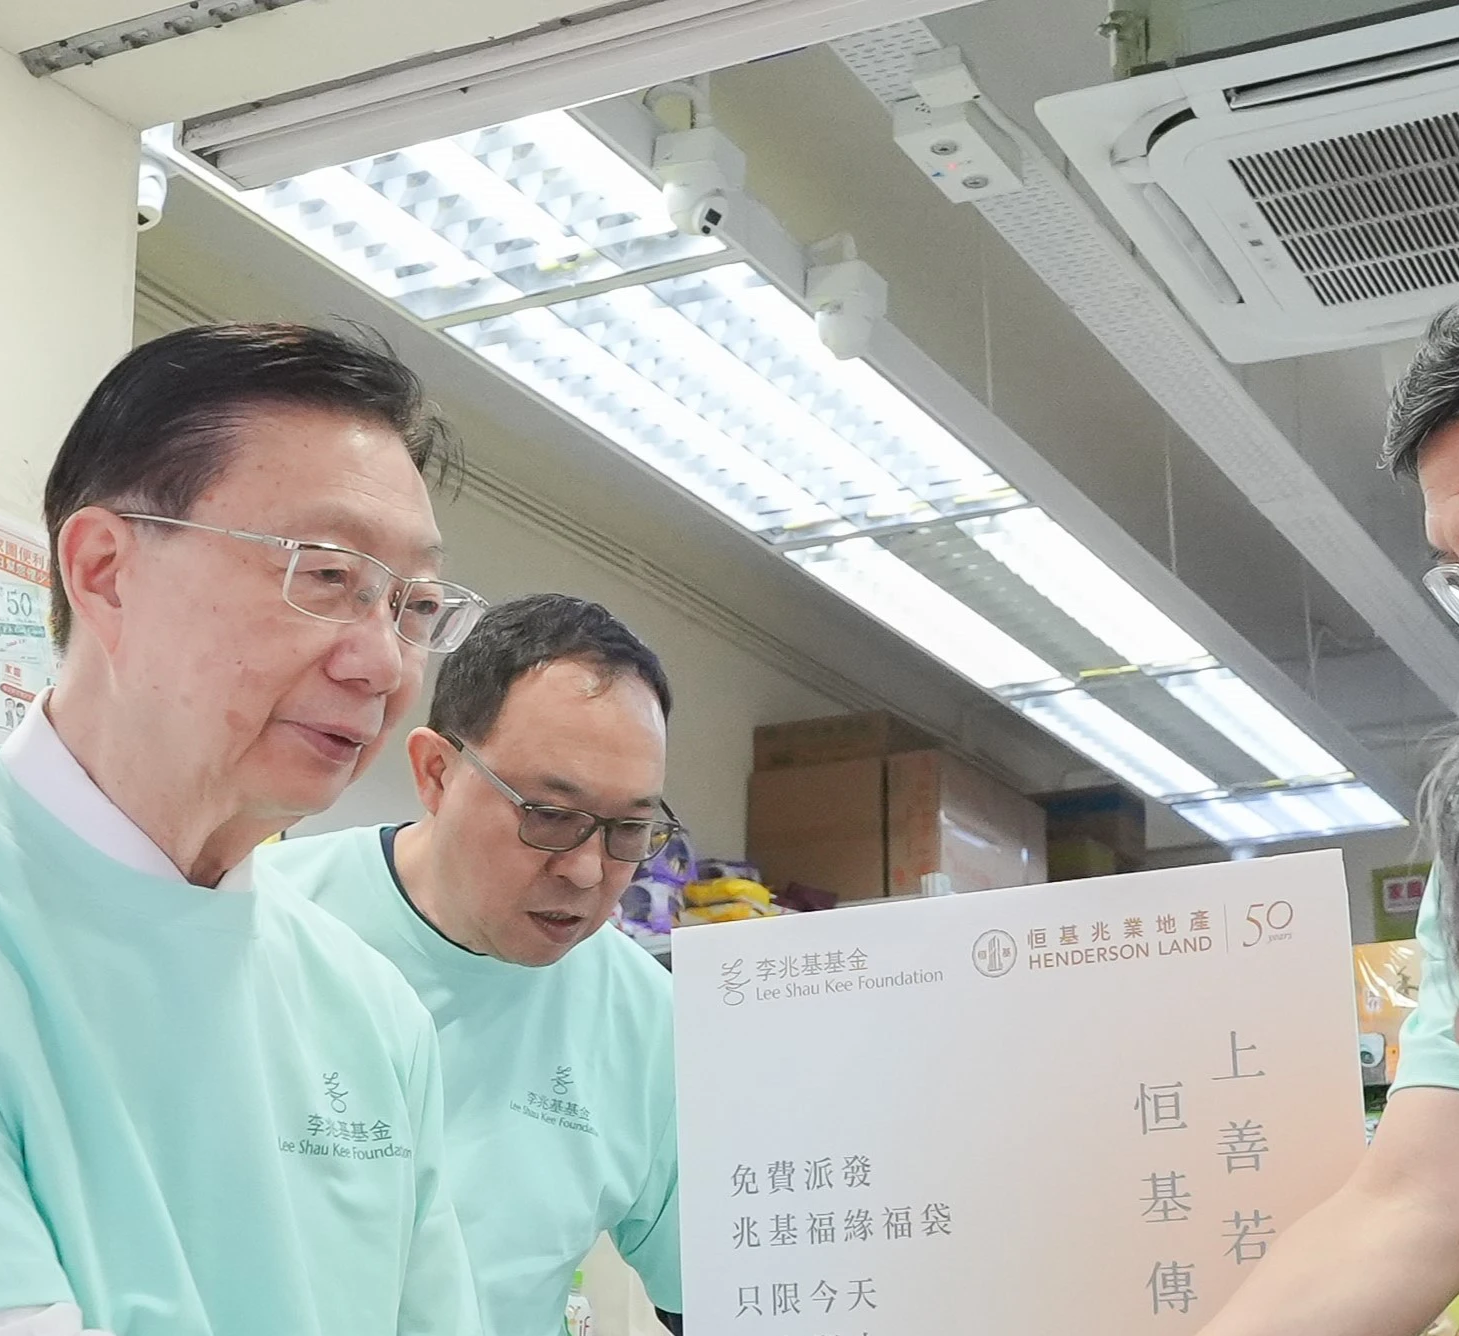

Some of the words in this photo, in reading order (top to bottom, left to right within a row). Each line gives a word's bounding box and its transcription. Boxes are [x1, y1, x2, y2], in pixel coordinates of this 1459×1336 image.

[1027, 910, 1211, 950] 恒基兆業地產
[1242, 900, 1293, 947] 50
[1268, 931, 1293, 943] years
[755, 947, 869, 981] 李兆基基金
[1029, 942, 1149, 970] HENDERSON
[1158, 936, 1212, 956] LAND
[756, 986, 781, 1001] Lee
[785, 982, 820, 999] Shau
[825, 979, 853, 994] Kee
[858, 968, 944, 990] Foundation
[527, 1091, 590, 1120] 李兆基基金
[307, 1113, 392, 1143] 李兆基基金
[299, 1139, 329, 1157] Shau
[730, 1154, 872, 1198] 免費派發
[731, 1202, 952, 1250] 兆基福緣福袋
[735, 1278, 878, 1318] 只限今天
